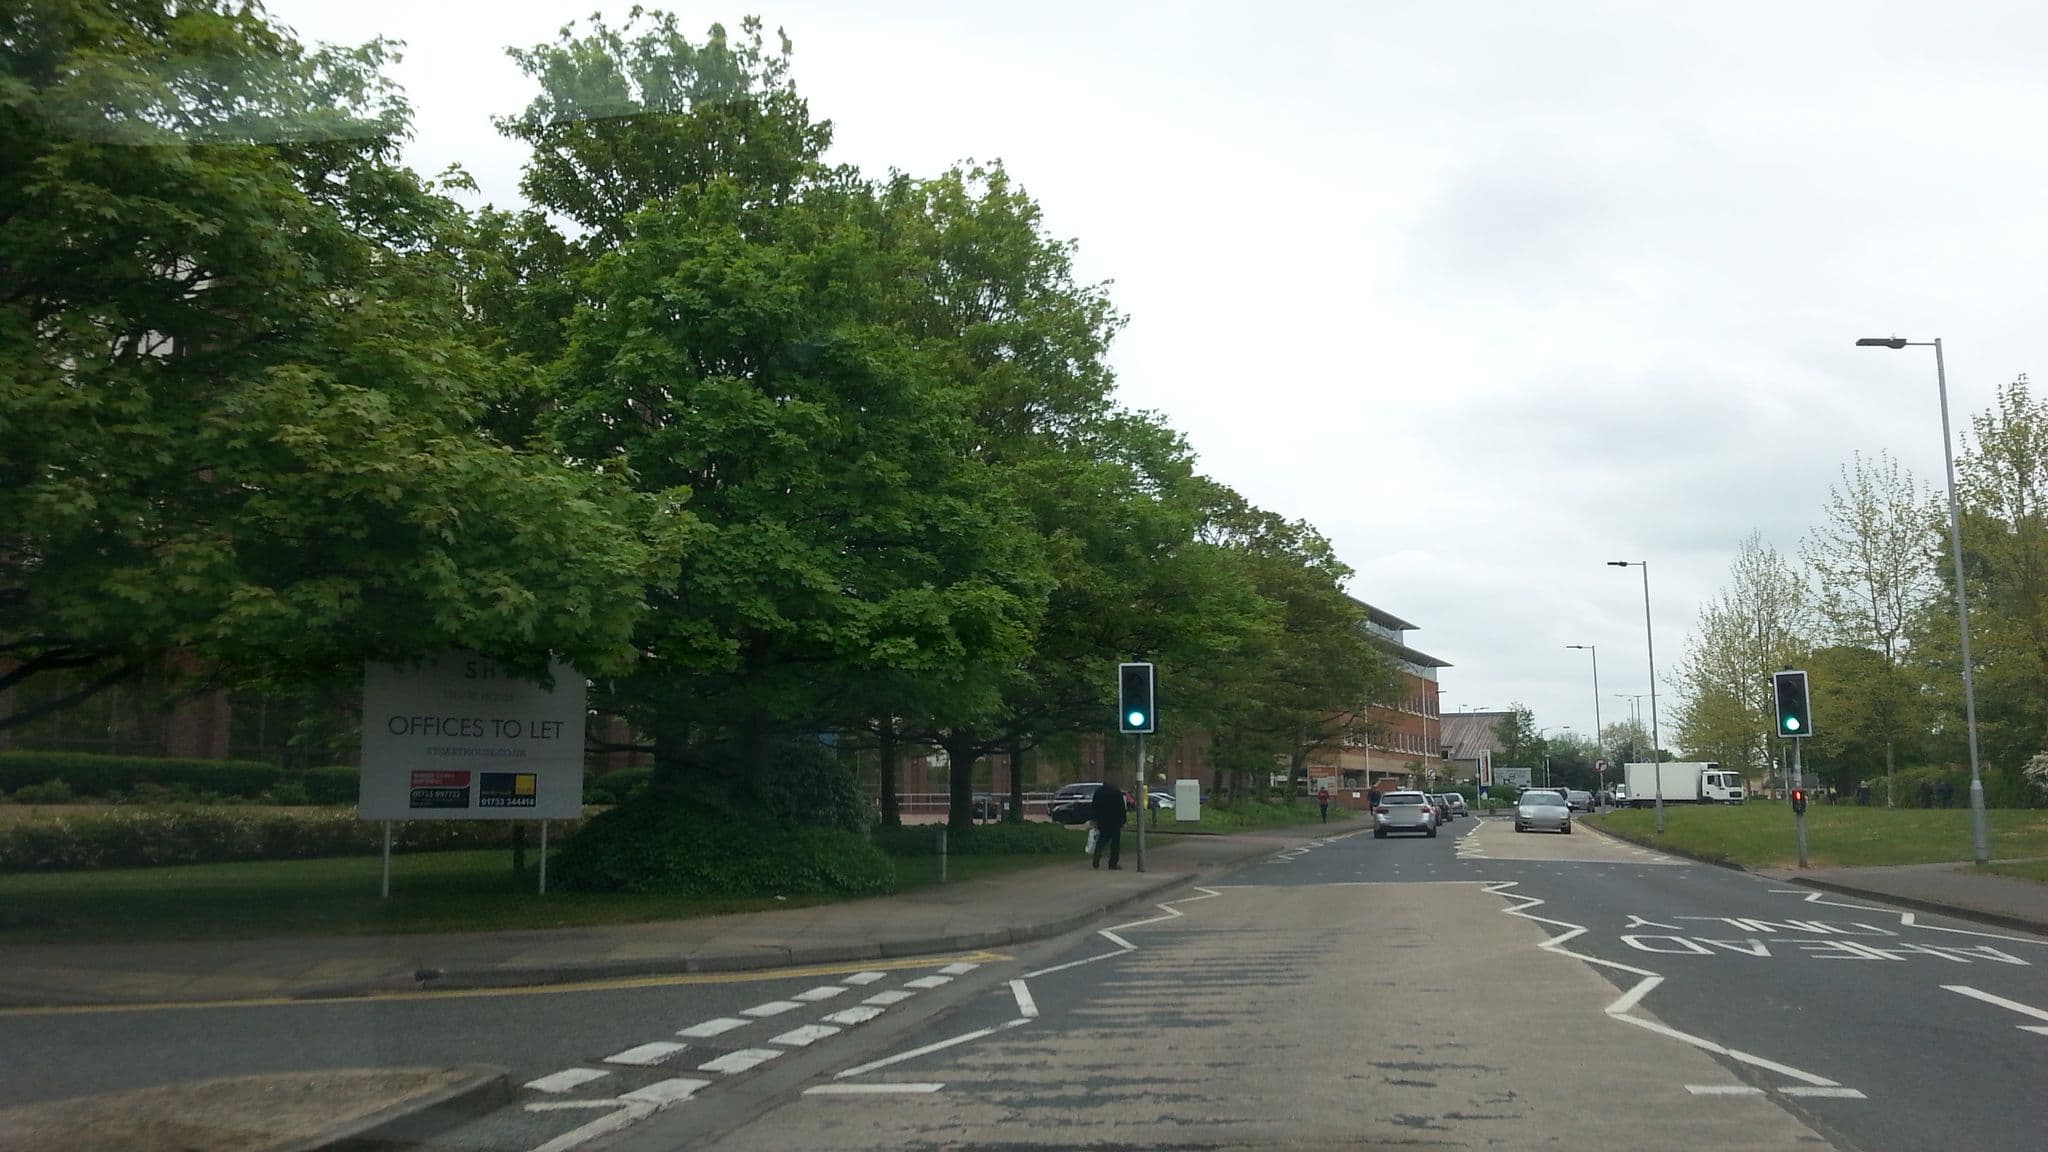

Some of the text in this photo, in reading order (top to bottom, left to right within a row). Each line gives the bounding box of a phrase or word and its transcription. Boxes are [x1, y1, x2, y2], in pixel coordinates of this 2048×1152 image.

[388, 715, 565, 741] OFFICES TO LET
[481, 797, 505, 807] 01733
